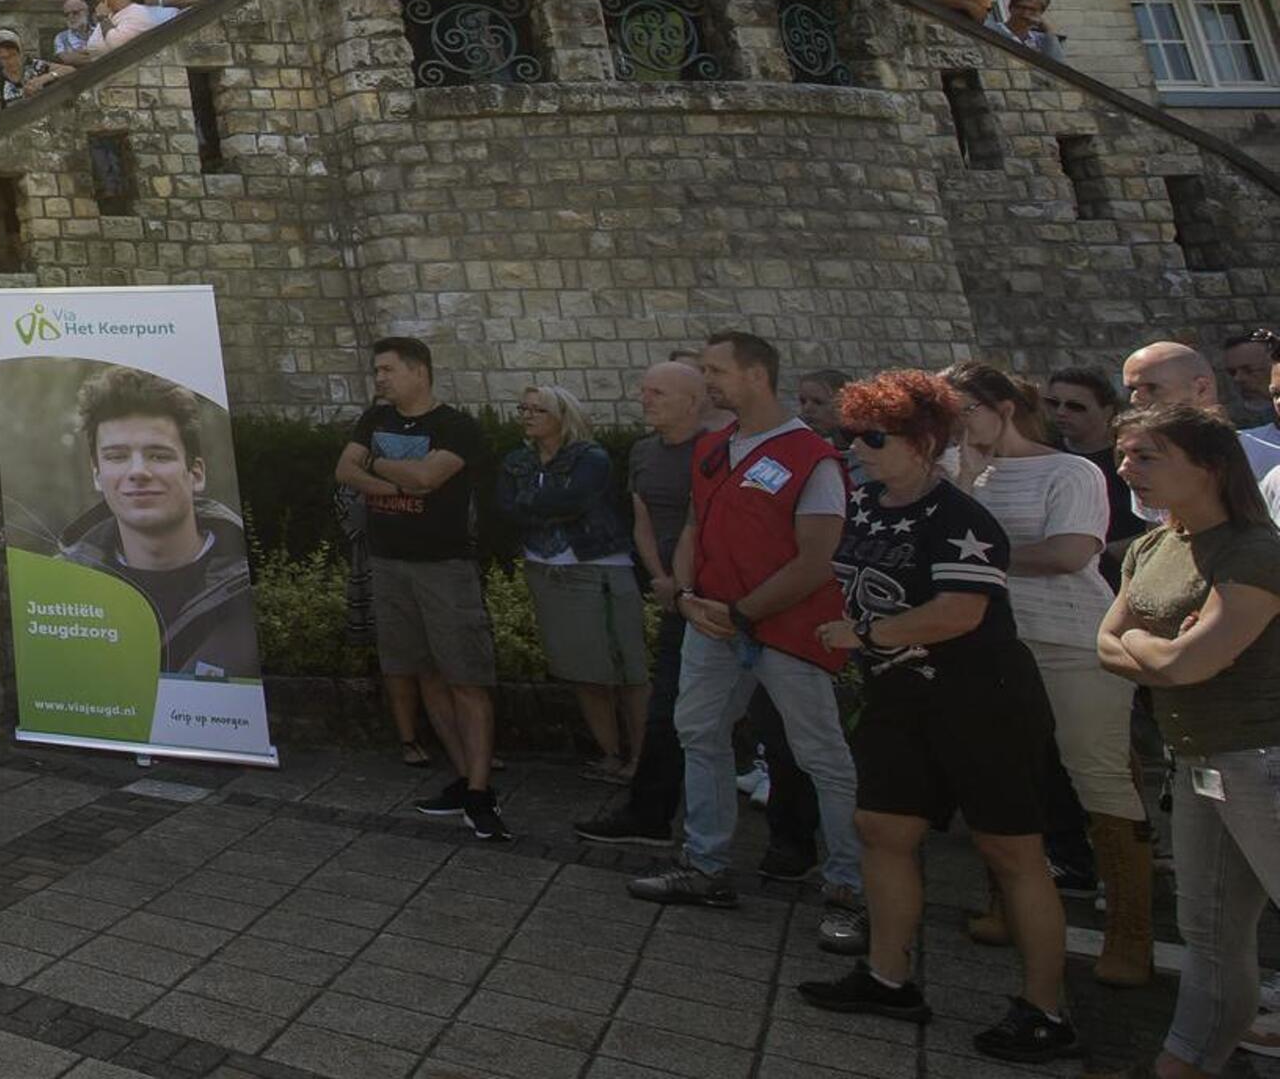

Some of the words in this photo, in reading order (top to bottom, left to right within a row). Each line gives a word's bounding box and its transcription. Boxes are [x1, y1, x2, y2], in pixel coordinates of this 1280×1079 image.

[52, 307, 77, 321] Via
[64, 322, 95, 335] Het
[98, 322, 175, 338] Keerpunt
[27, 600, 104, 618] Justitiële
[28, 620, 119, 642] Jeugdzorg
[34, 700, 137, 717] www.viajeugd.nl
[170, 709, 191, 725] Grip
[211, 716, 250, 730] morgen
